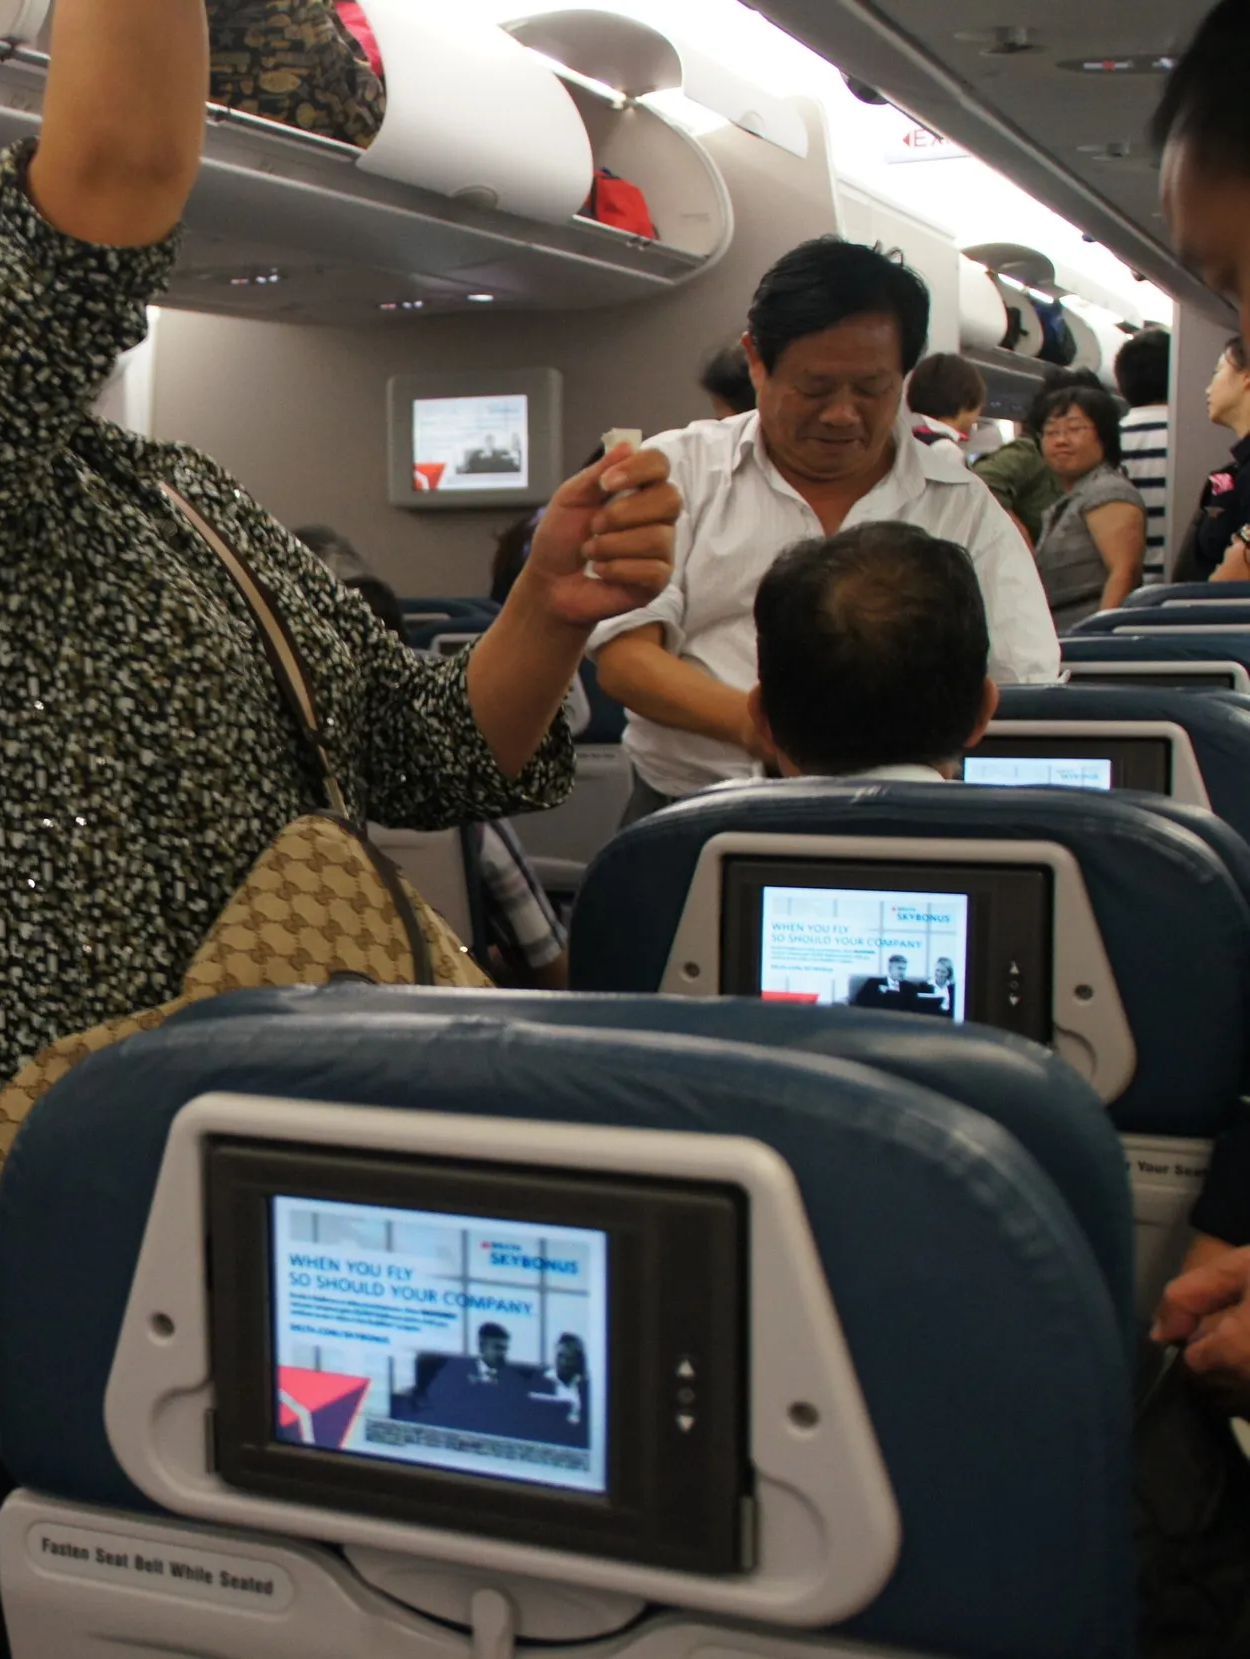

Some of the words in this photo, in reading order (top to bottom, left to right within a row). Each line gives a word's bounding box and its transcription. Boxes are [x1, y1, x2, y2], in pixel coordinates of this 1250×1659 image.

[897, 912, 951, 923] SKYBONUS
[771, 922, 804, 932] WHEN
[807, 923, 830, 933] YOU
[833, 924, 849, 934] FLY
[771, 933, 786, 943] SO
[789, 934, 831, 945] SHOULD
[835, 936, 863, 947] YOUR
[867, 937, 922, 949] COMPANY
[1137, 1160, 1169, 1174] Your
[289, 1253, 341, 1272] WHEN
[346, 1260, 382, 1278] YOU
[387, 1264, 414, 1281] FLY
[490, 1253, 578, 1275] SKYBONUS
[289, 1271, 311, 1287] SO
[316, 1274, 385, 1297] SHOULD
[391, 1285, 438, 1302] YOUR
[443, 1290, 532, 1315] COMPANY
[42, 1537, 90, 1561] Fasten
[95, 1548, 128, 1569] Seat
[135, 1555, 164, 1575] Belt
[169, 1561, 214, 1585] While
[220, 1572, 275, 1596] Seated
